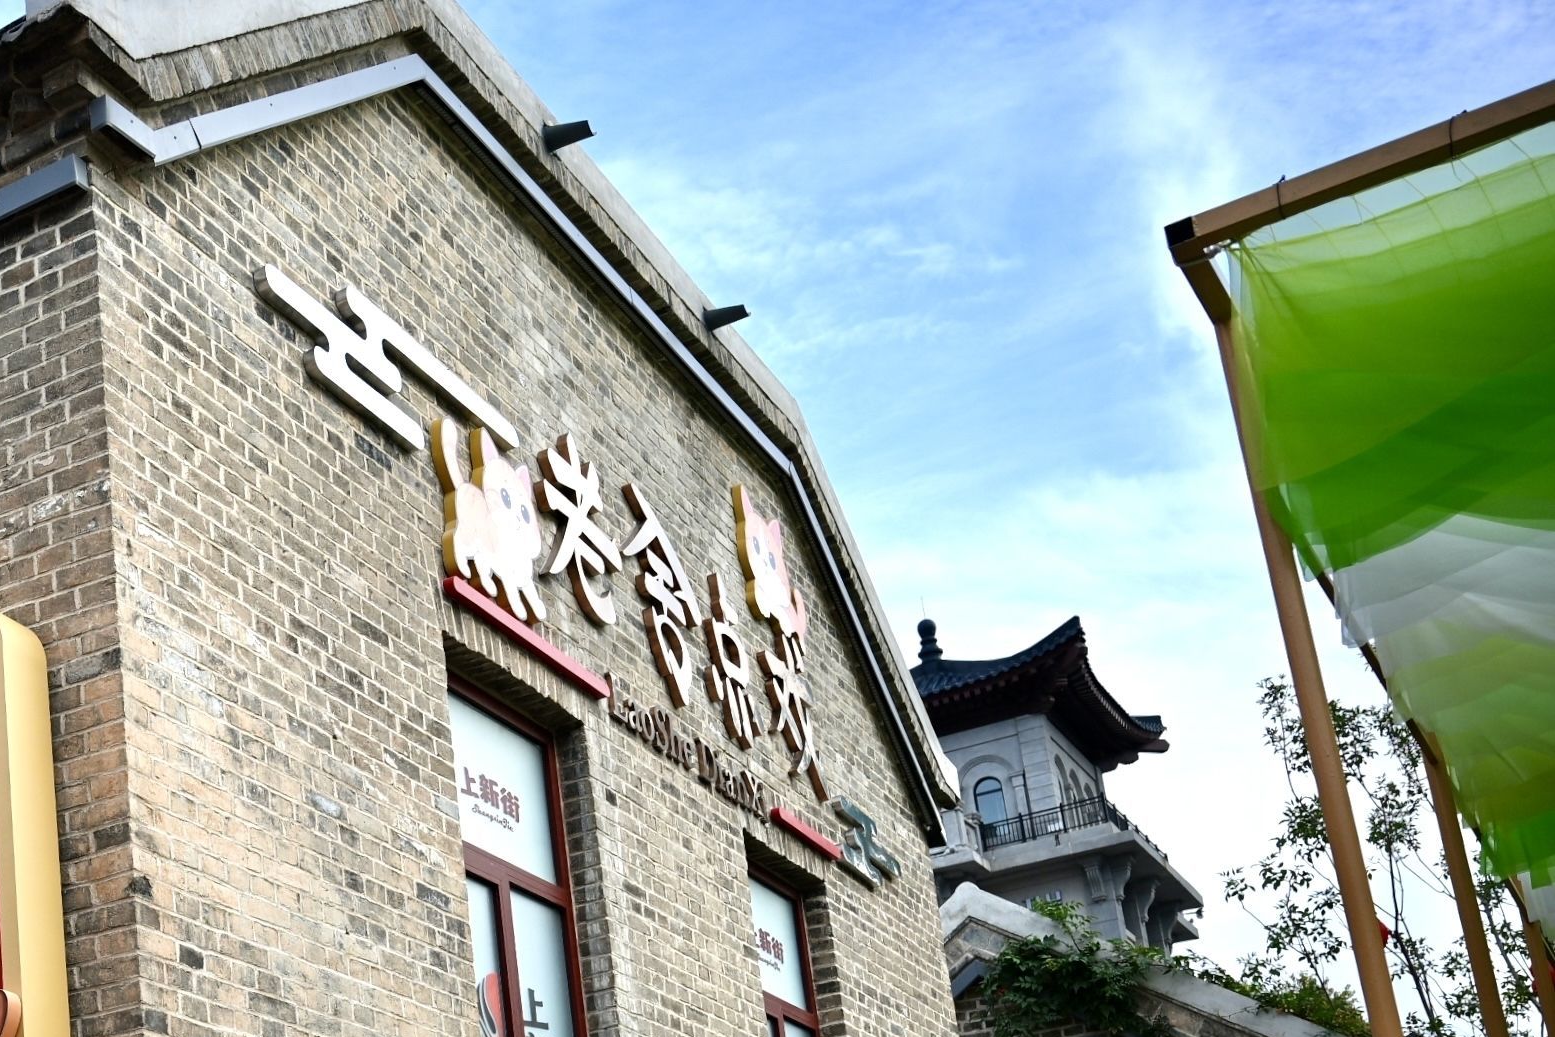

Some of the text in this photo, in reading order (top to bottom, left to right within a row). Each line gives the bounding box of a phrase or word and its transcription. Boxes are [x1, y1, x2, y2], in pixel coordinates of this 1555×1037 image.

[534, 432, 830, 801] 老舍点戏
[460, 766, 520, 824] 上新街
